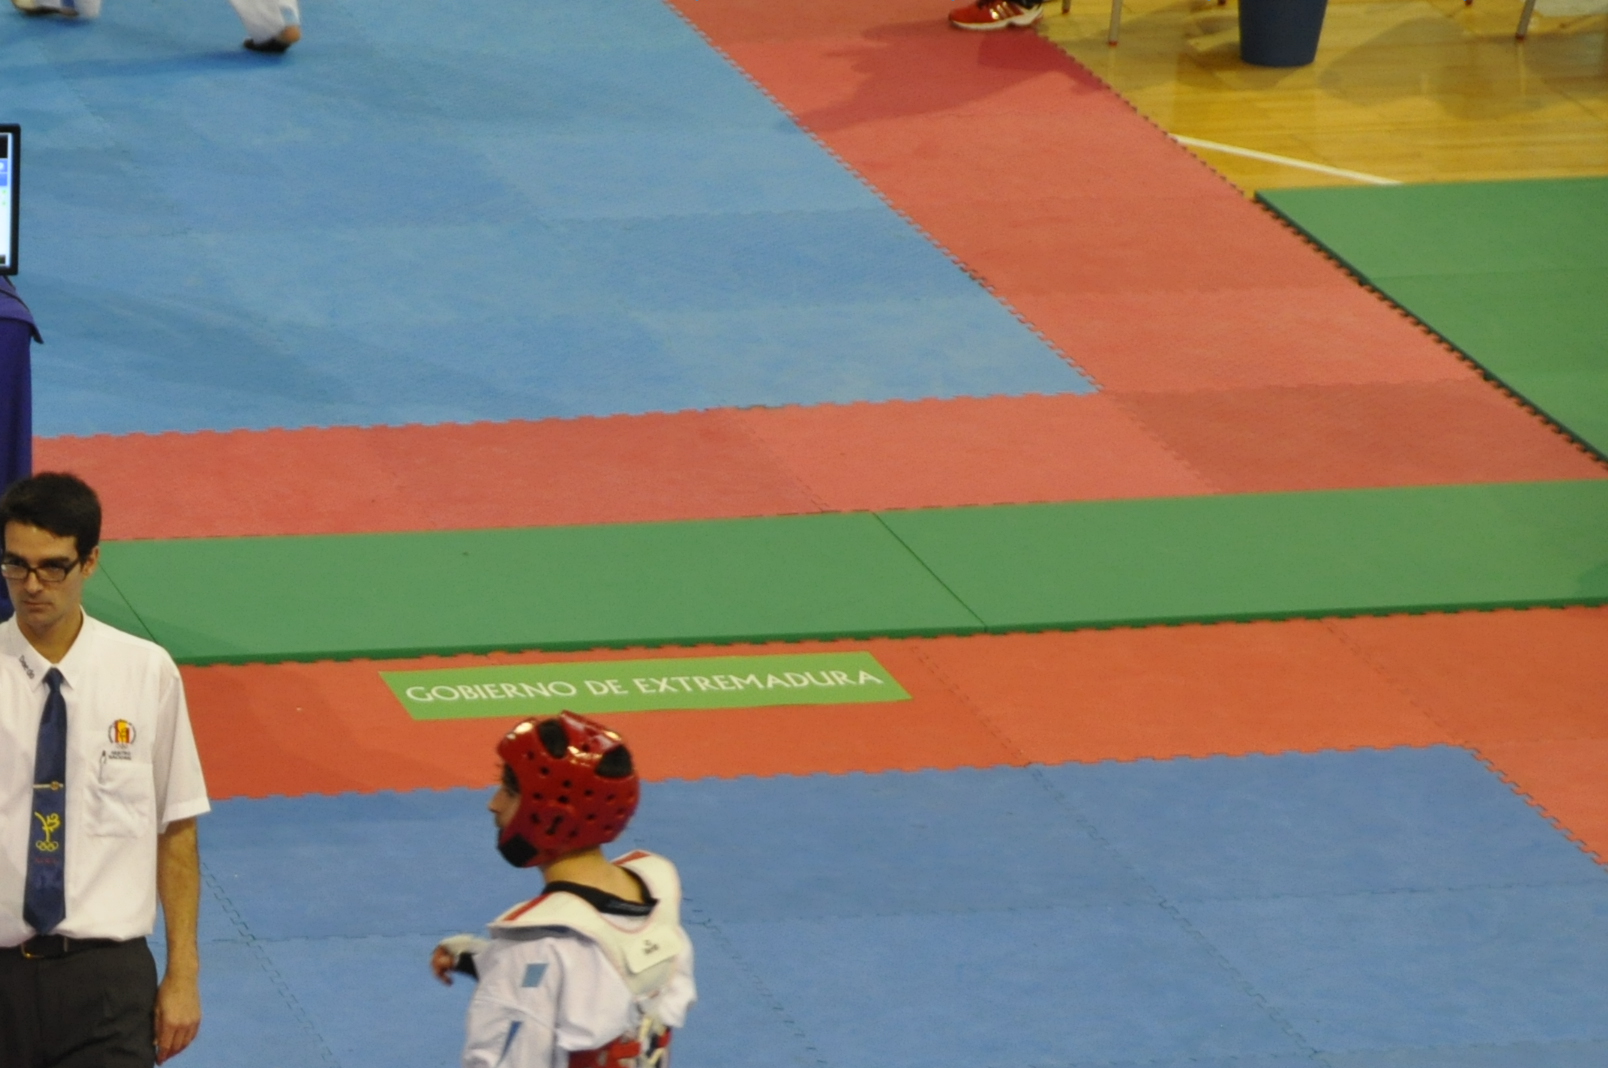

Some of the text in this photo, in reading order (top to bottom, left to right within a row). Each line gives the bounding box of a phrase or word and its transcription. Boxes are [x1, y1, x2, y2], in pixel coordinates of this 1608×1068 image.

[405, 669, 884, 702] GOBIERNO DE EXTREMADURA
